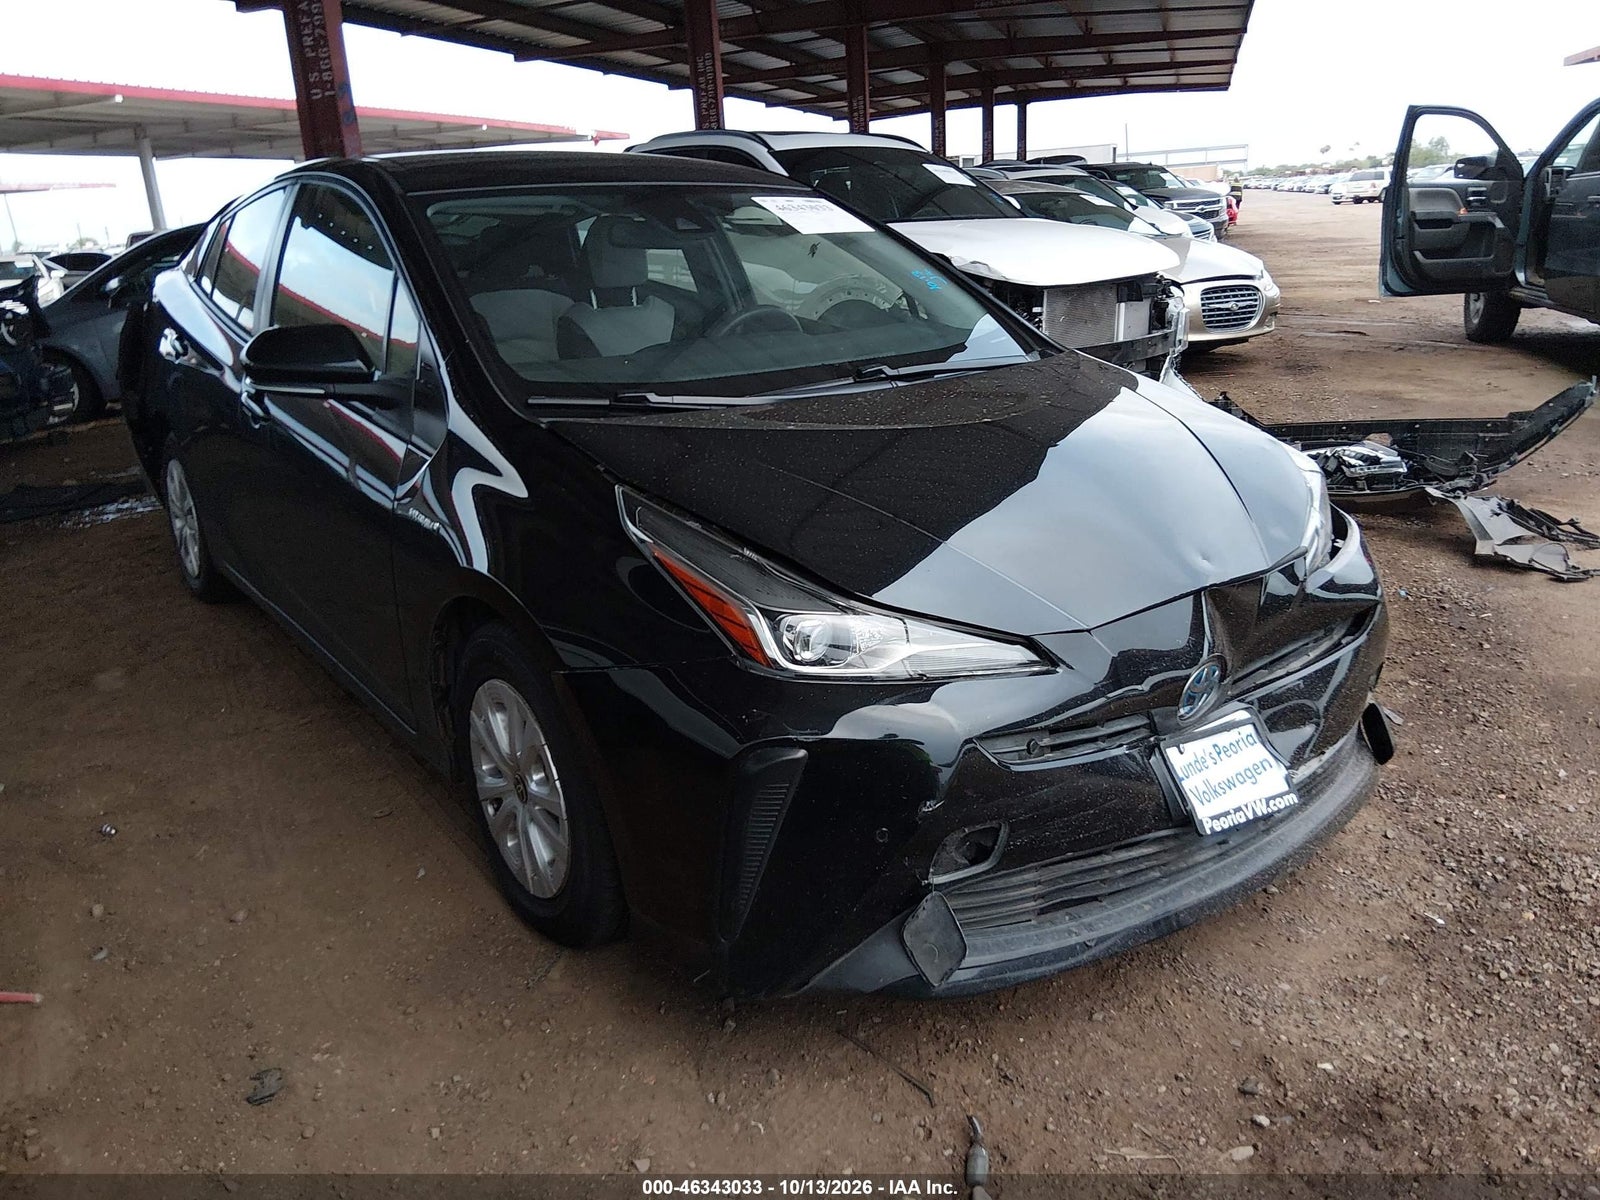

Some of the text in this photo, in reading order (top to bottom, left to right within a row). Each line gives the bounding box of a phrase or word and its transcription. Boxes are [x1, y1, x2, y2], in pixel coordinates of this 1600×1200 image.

[1212, 731, 1258, 761] Peoria
[1189, 758, 1273, 806] Volkswagen
[1202, 792, 1299, 835] PeoriaVW.com
